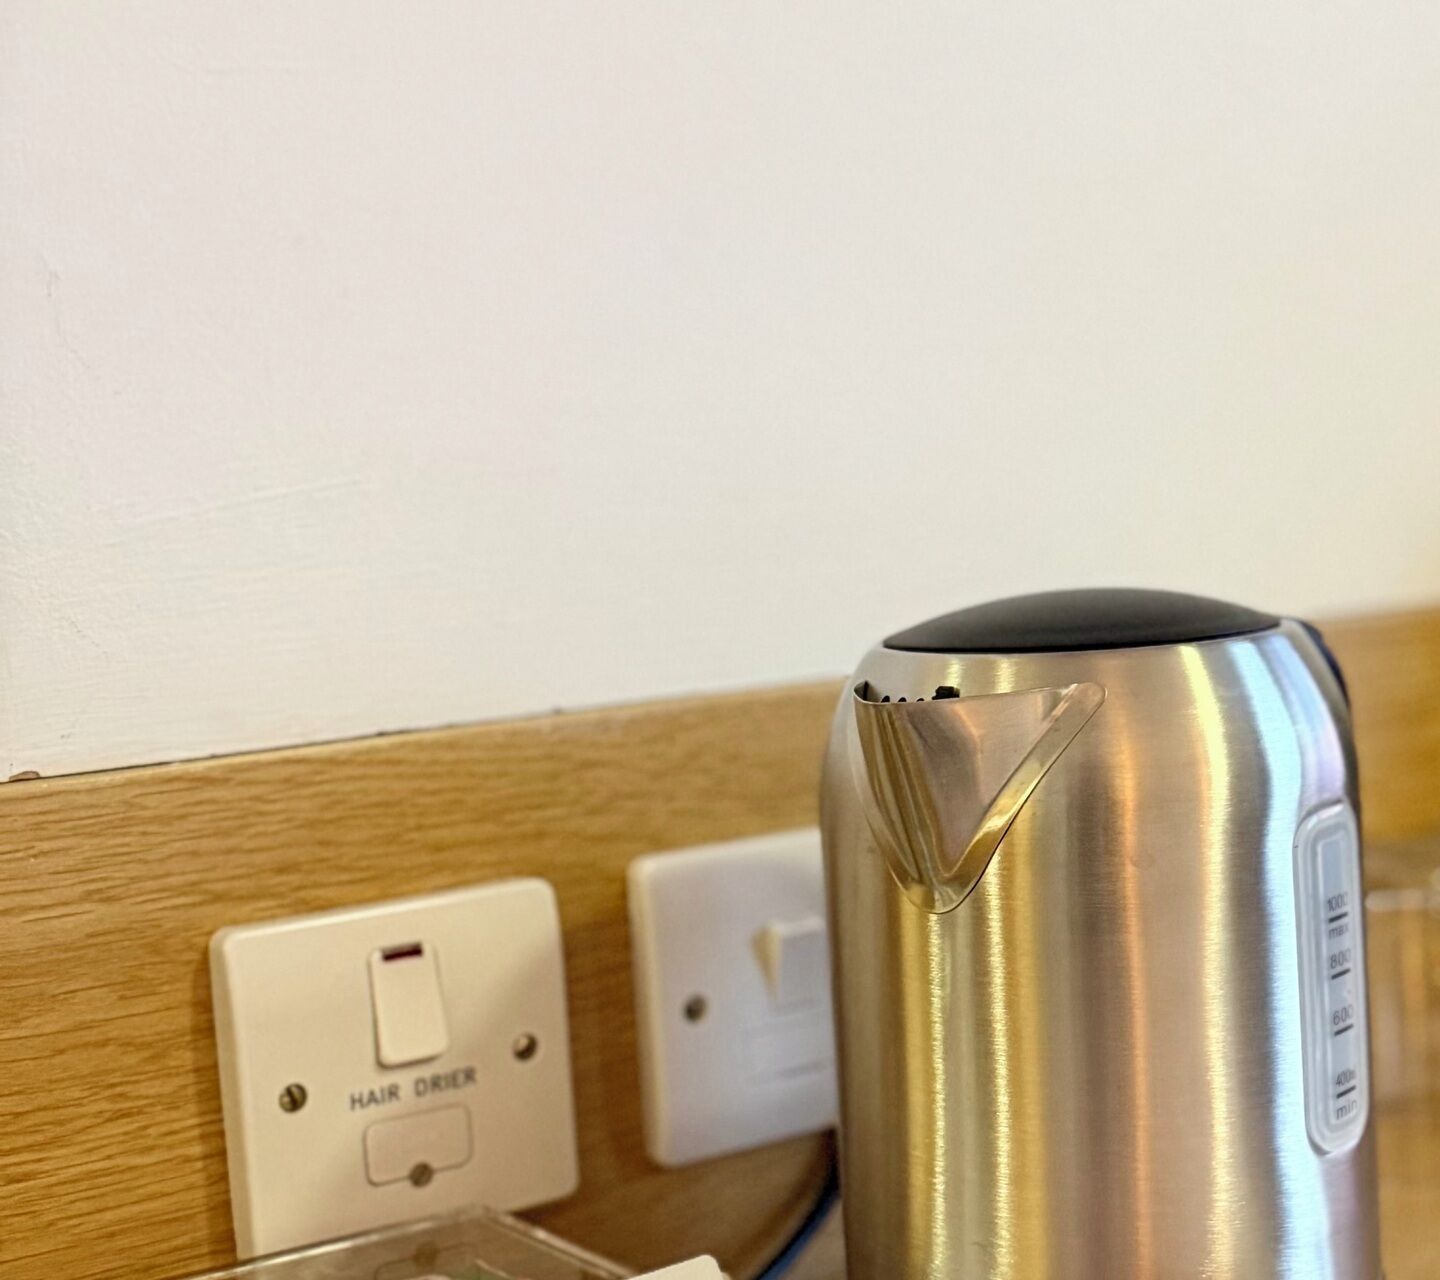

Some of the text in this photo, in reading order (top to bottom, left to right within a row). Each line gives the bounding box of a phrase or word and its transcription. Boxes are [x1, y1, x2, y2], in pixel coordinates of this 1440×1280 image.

[1329, 947, 1352, 969] 800
[1332, 1004, 1354, 1026] 600
[349, 1067, 478, 1111] HAIR DRIER
[1336, 1100, 1357, 1120] min
